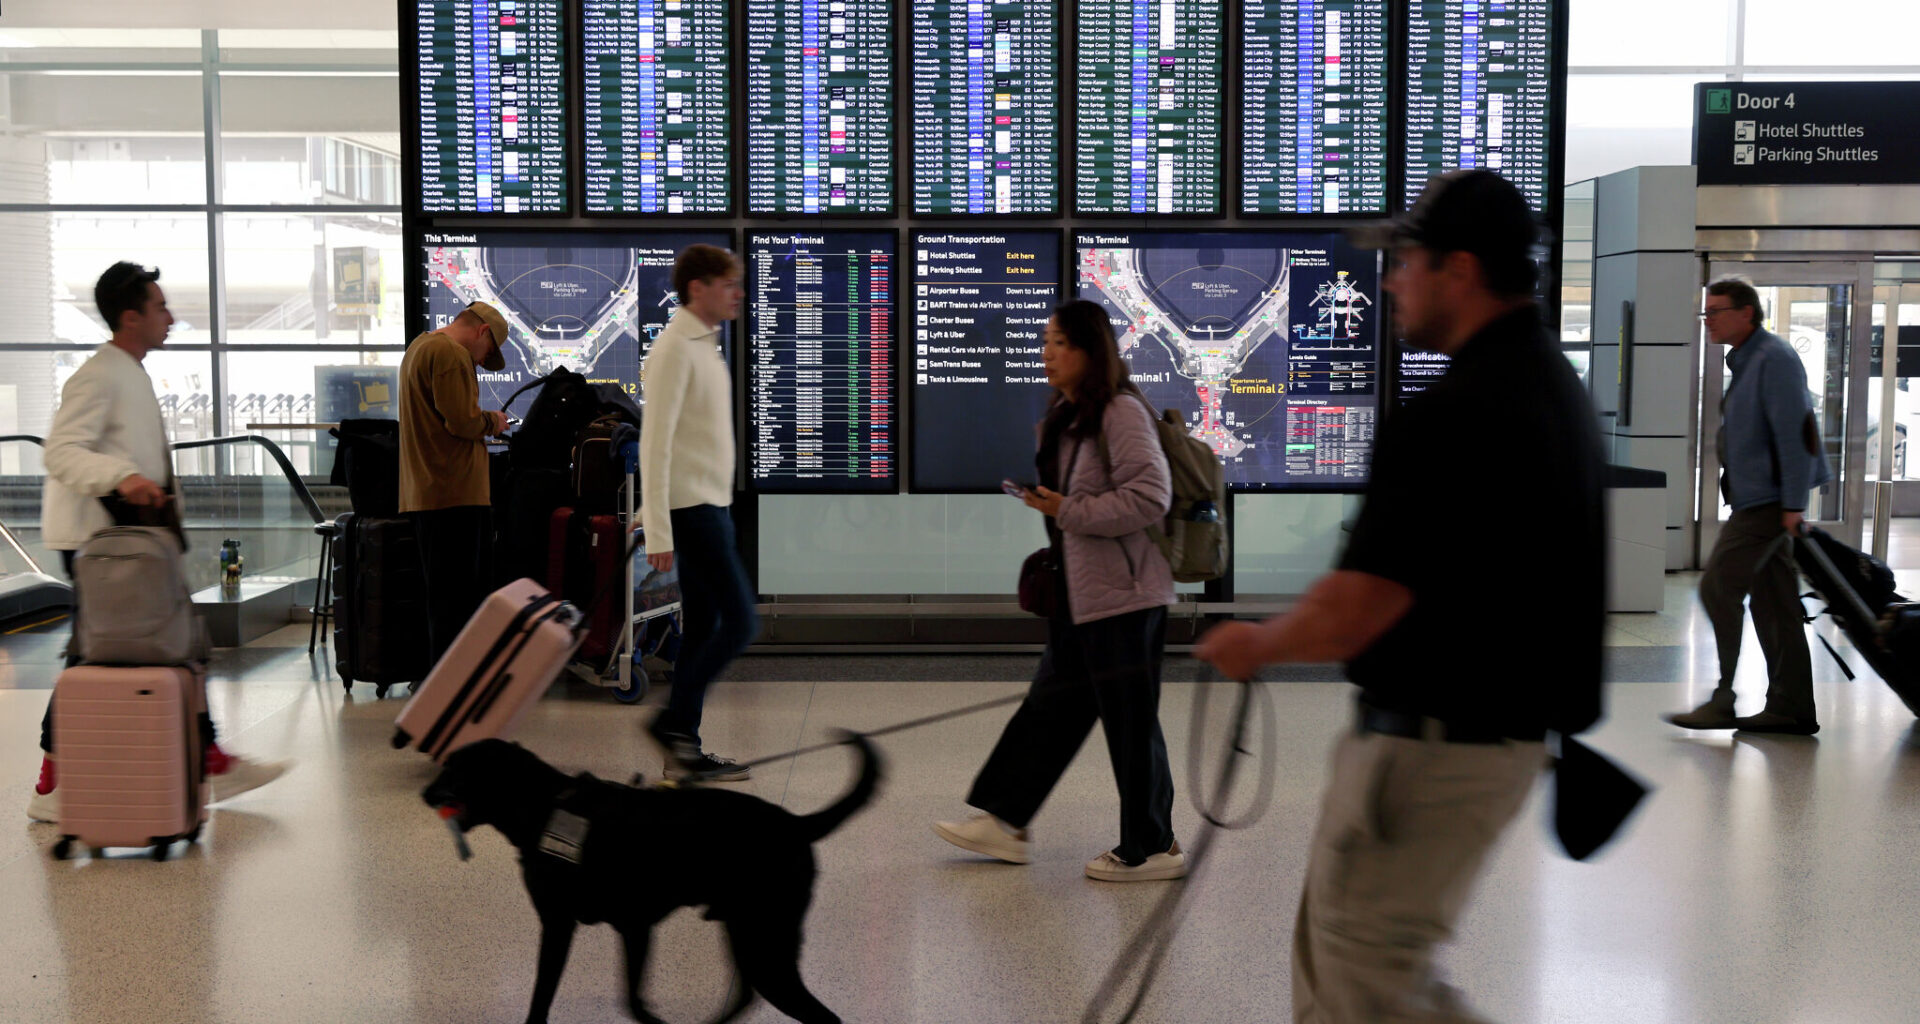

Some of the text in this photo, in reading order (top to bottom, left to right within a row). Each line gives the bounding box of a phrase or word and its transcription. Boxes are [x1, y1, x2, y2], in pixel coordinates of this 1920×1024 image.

[1738, 93, 1795, 108] Door 4
[1760, 124, 1864, 137] Hotel Shuttles
[1759, 147, 1878, 164] Parking Shuttles
[425, 234, 476, 242] This Terminal
[753, 235, 824, 244] Find Your Terminal
[918, 235, 1005, 243] Ground Transportation
[930, 331, 943, 339] Lyft
[477, 372, 521, 381] erminal 1
[1165, 372, 1169, 382] 1
[630, 384, 636, 393] 2
[1230, 384, 1284, 393] Terminal 2
